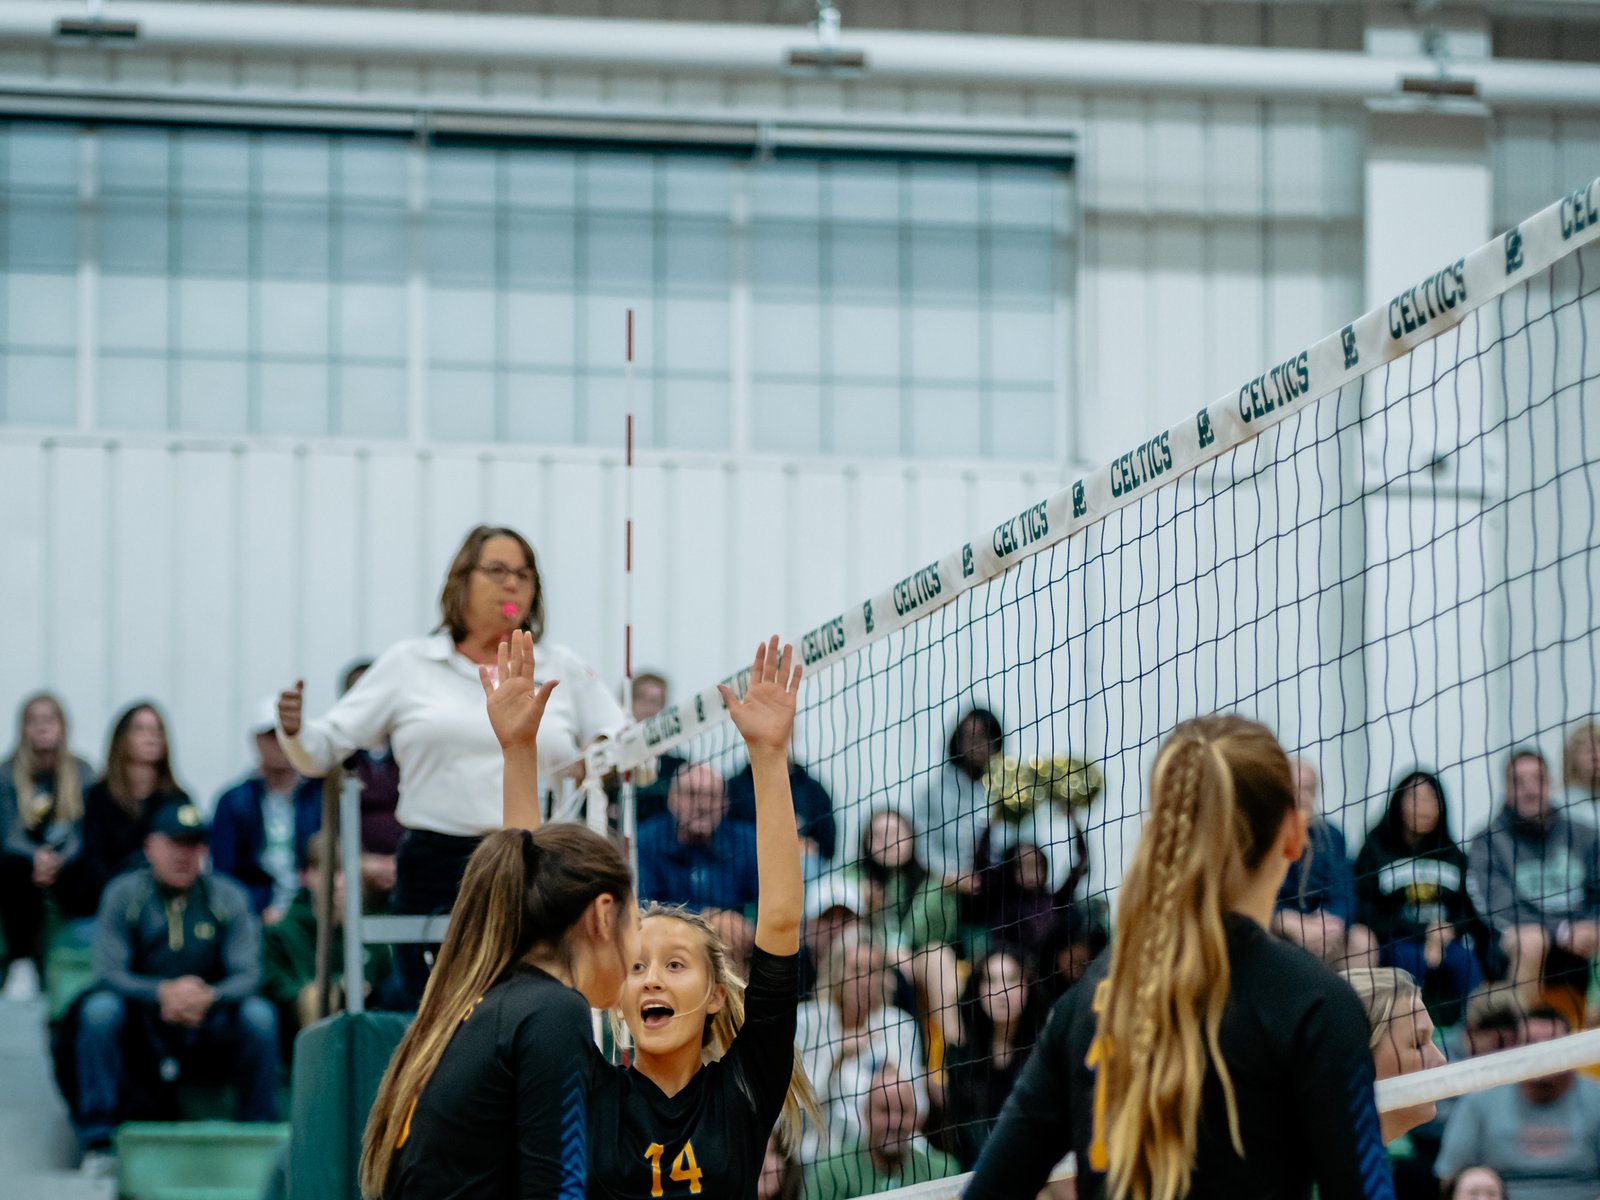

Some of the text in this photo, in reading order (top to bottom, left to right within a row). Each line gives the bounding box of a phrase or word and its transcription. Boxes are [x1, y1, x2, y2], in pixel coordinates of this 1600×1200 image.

[801, 615, 845, 667] CELTICS
[893, 560, 942, 617] CELTICS
[993, 499, 1048, 559] CELTICS
[1110, 429, 1172, 498] CELTICS
[1238, 350, 1309, 424] CELTICS
[1388, 256, 1467, 341] CELTICS
[644, 1139, 703, 1197] 14
